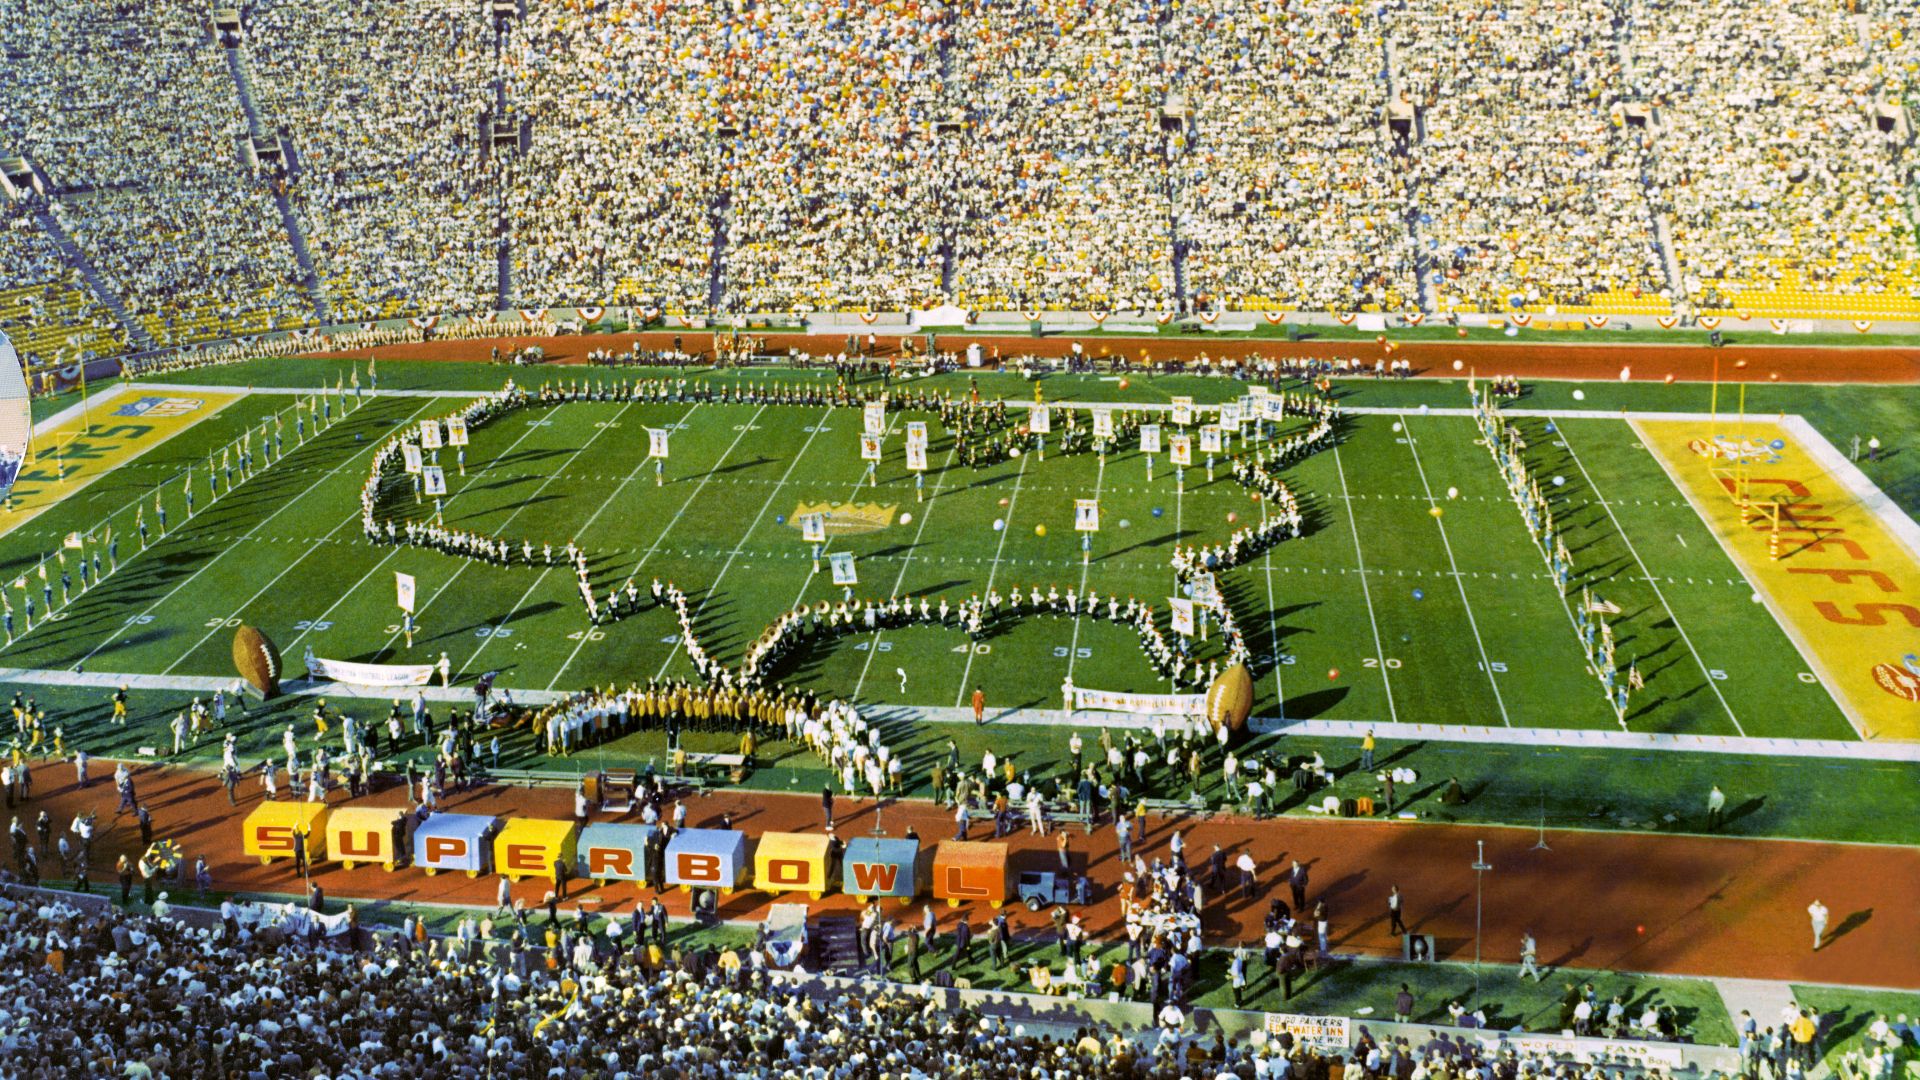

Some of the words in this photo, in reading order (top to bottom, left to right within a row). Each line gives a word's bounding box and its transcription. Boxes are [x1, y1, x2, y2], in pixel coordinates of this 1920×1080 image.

[1719, 477, 1920, 628] CHIEFS
[125, 615, 156, 625] 15
[204, 618, 243, 627] 20
[293, 620, 335, 631] 25
[475, 628, 514, 638] 35
[566, 631, 606, 641] 40
[853, 642, 893, 652] 45
[950, 644, 991, 654] 40
[1053, 647, 1092, 658] 35
[1362, 658, 1402, 668] 20
[1478, 661, 1508, 672] 15
[1709, 669, 1728, 680] 5
[1300, 1016, 1343, 1027] PACKERS
[1269, 1023, 1323, 1036] EDEWATER
[1325, 1026, 1344, 1037] INN
[1604, 1045, 1648, 1055] FANS
